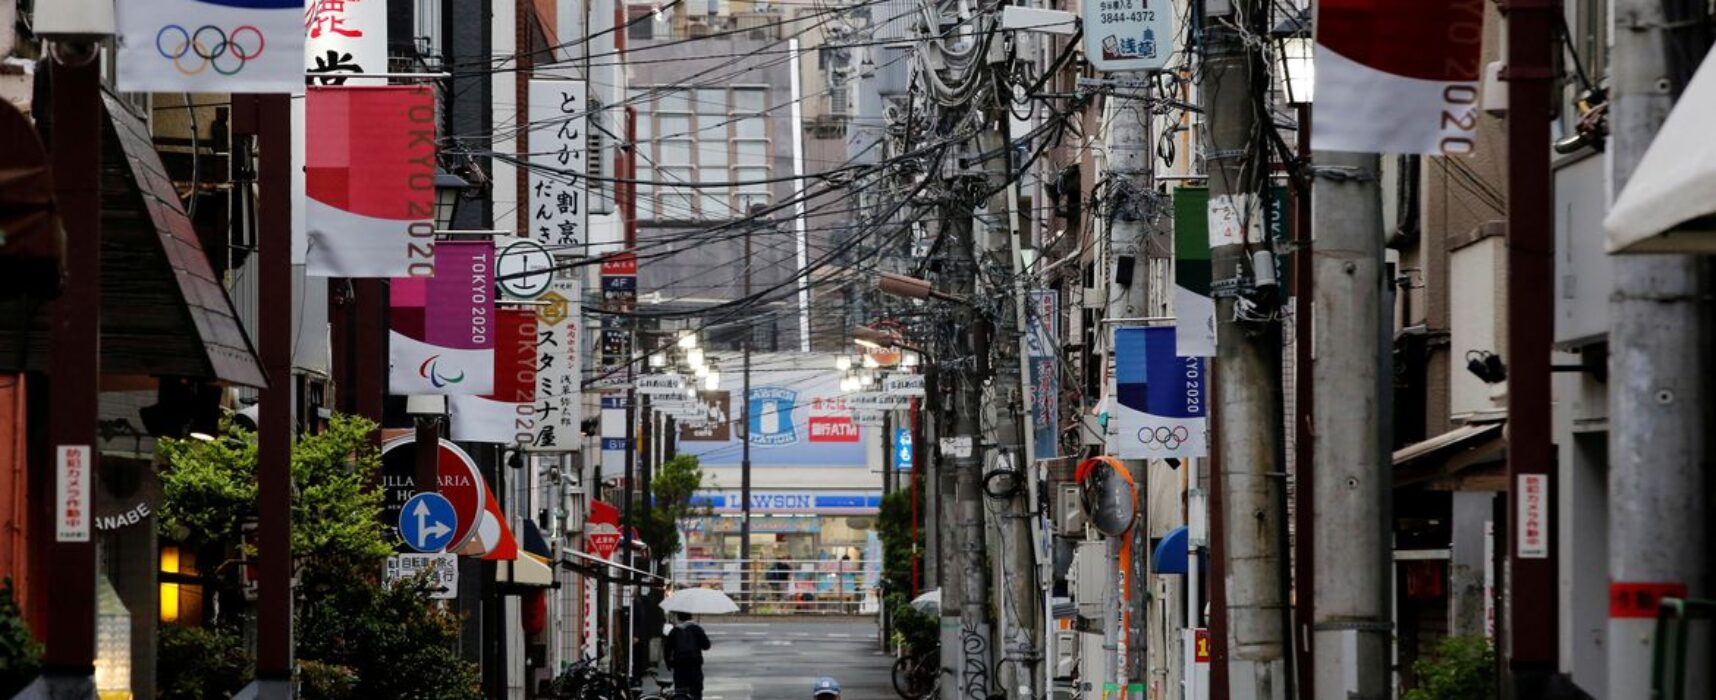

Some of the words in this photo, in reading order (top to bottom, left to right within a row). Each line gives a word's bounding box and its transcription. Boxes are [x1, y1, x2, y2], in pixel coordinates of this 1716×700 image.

[1101, 11, 1155, 24] 3844-4372
[1440, 56, 1479, 155] 2020
[557, 91, 579, 245] とんかつ割烹
[407, 201, 434, 278] 2020
[471, 253, 487, 304] TOKYO
[611, 278, 628, 287] 4F
[471, 307, 487, 344] 2020
[532, 330, 559, 447] スタミナ屋
[750, 388, 795, 402] AWSON
[1186, 381, 1200, 413] 2020
[514, 388, 536, 444] 2020
[750, 431, 794, 445] TATION
[66, 448, 81, 528] 防犯カメラ作動中
[383, 475, 415, 487] ILLA
[437, 475, 470, 487] ARIA
[730, 495, 811, 508] LWSON
[402, 557, 454, 568] 自転車除く
